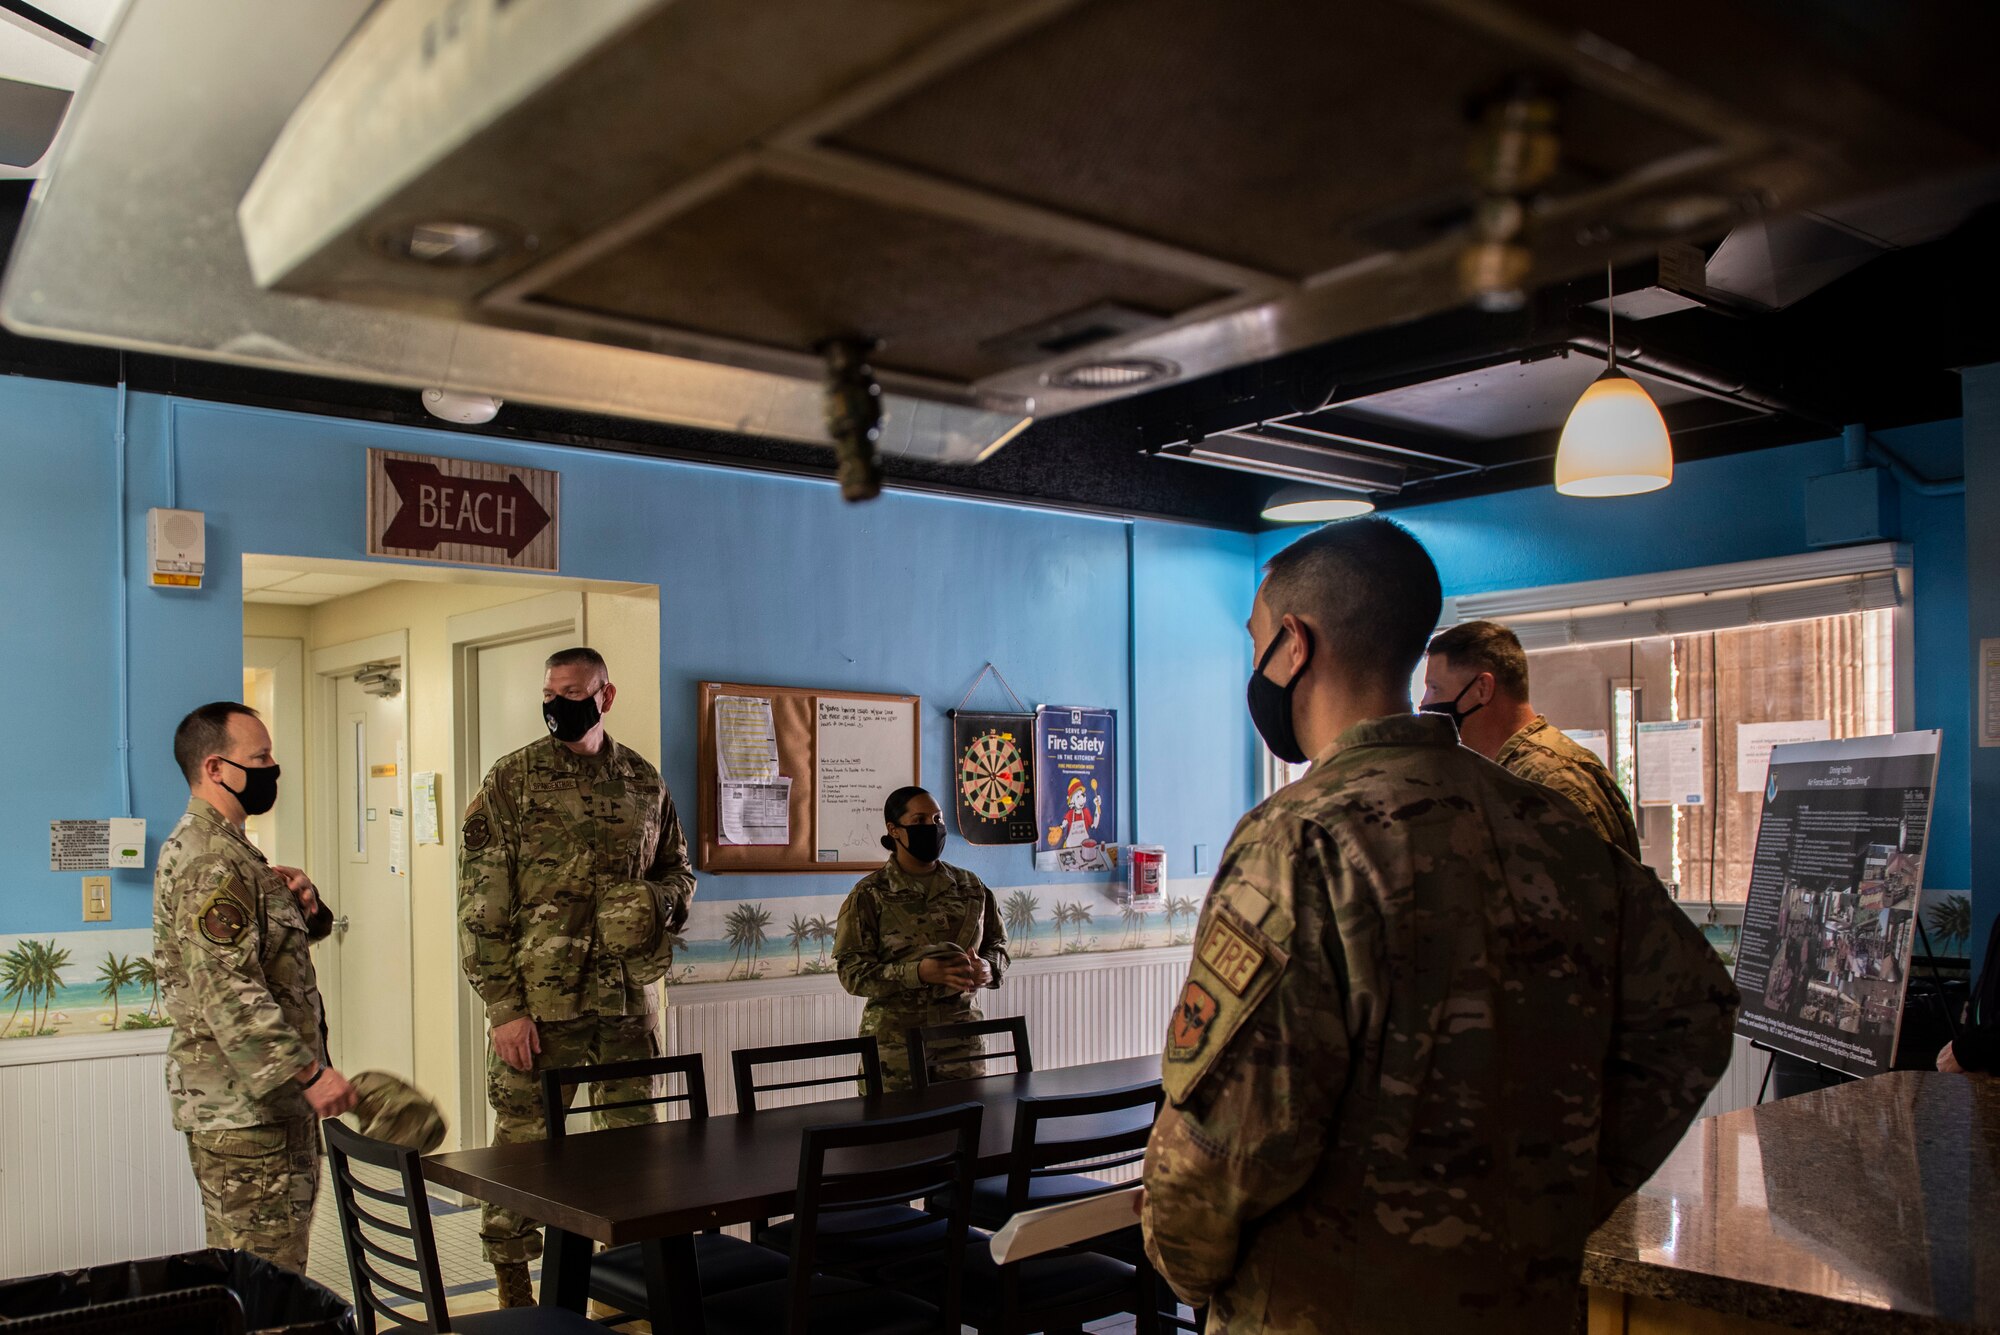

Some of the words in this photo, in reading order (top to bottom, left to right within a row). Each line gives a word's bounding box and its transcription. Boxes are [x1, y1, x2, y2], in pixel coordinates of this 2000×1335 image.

[419, 484, 517, 537] BEACH
[1048, 734, 1067, 750] Fire
[1070, 735, 1104, 755] Safety
[1202, 926, 1258, 987] FIRE
